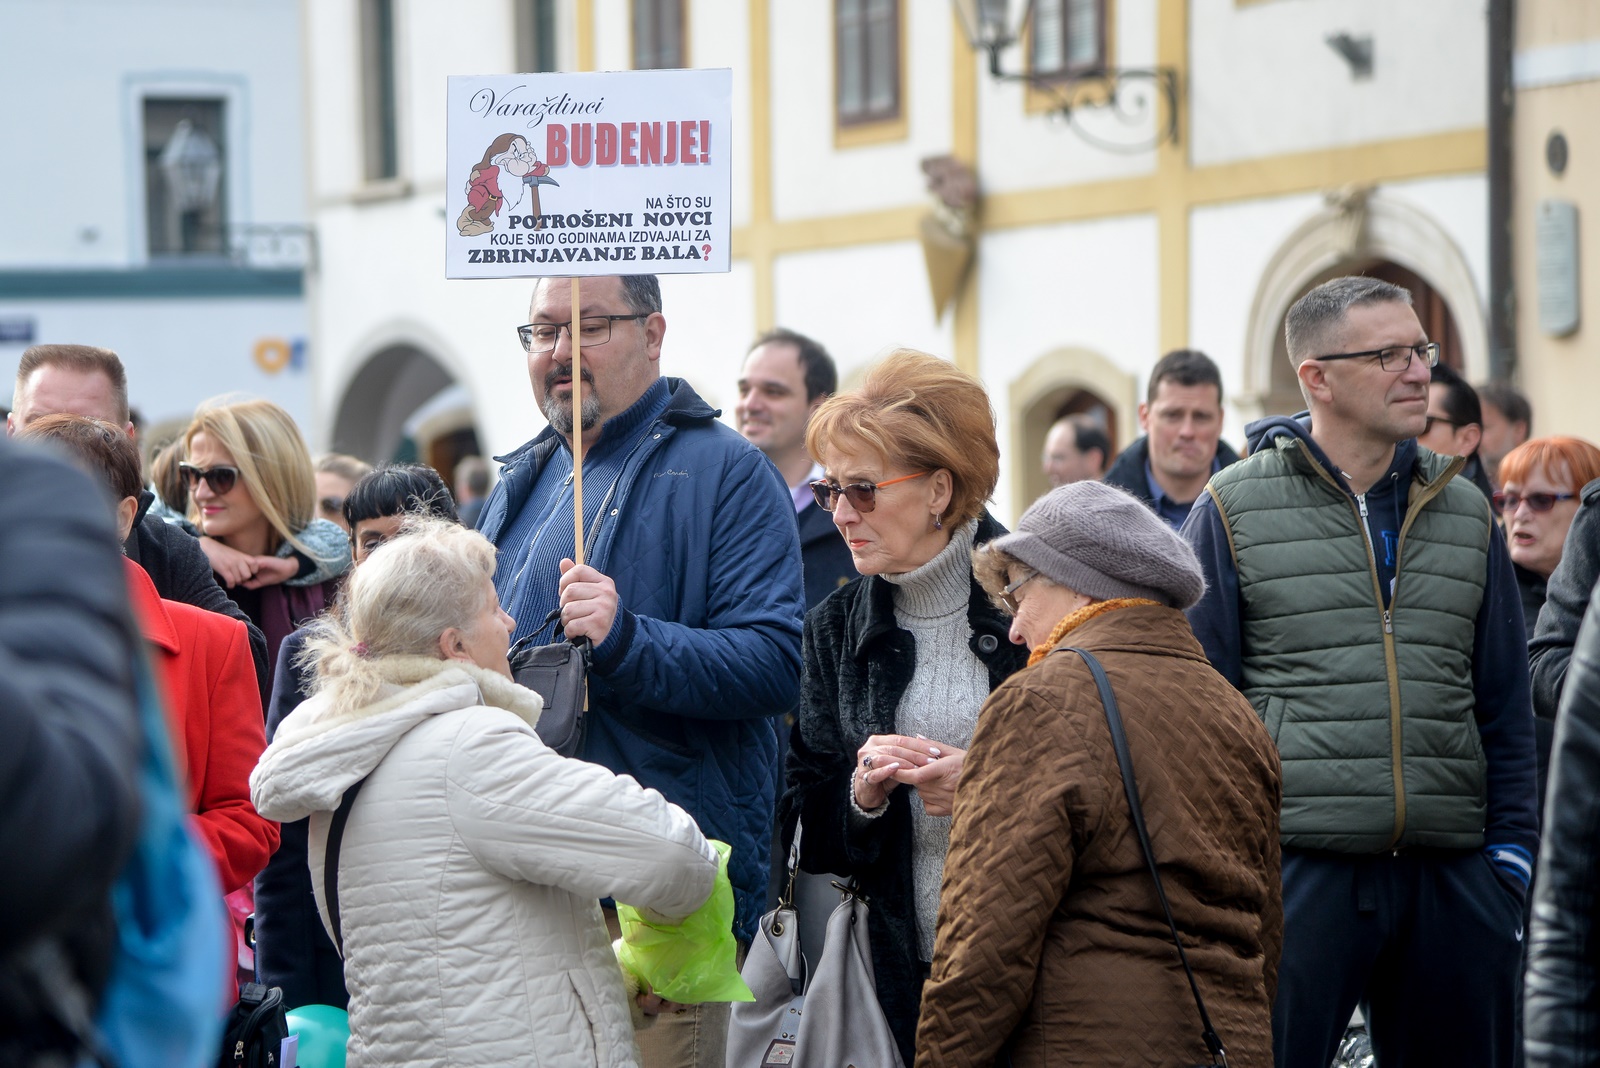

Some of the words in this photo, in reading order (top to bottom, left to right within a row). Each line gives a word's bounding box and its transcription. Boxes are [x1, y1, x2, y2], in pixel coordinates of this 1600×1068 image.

[469, 85, 604, 129] Varaždinci
[546, 120, 712, 168] BUĐENJE!
[645, 197, 663, 209] NA
[666, 194, 693, 209] ŠTO
[695, 196, 712, 209] SU
[508, 210, 633, 230] POTROŠENI
[643, 212, 713, 227] NOVCI
[490, 233, 524, 246] KOJE
[527, 232, 555, 245] SMO
[558, 231, 626, 245] GODINAMA
[629, 230, 692, 243] IZDVAJALI
[694, 230, 711, 242] ZA
[468, 247, 637, 264] ZBRINJAVANJE
[641, 244, 712, 262] BALA?
